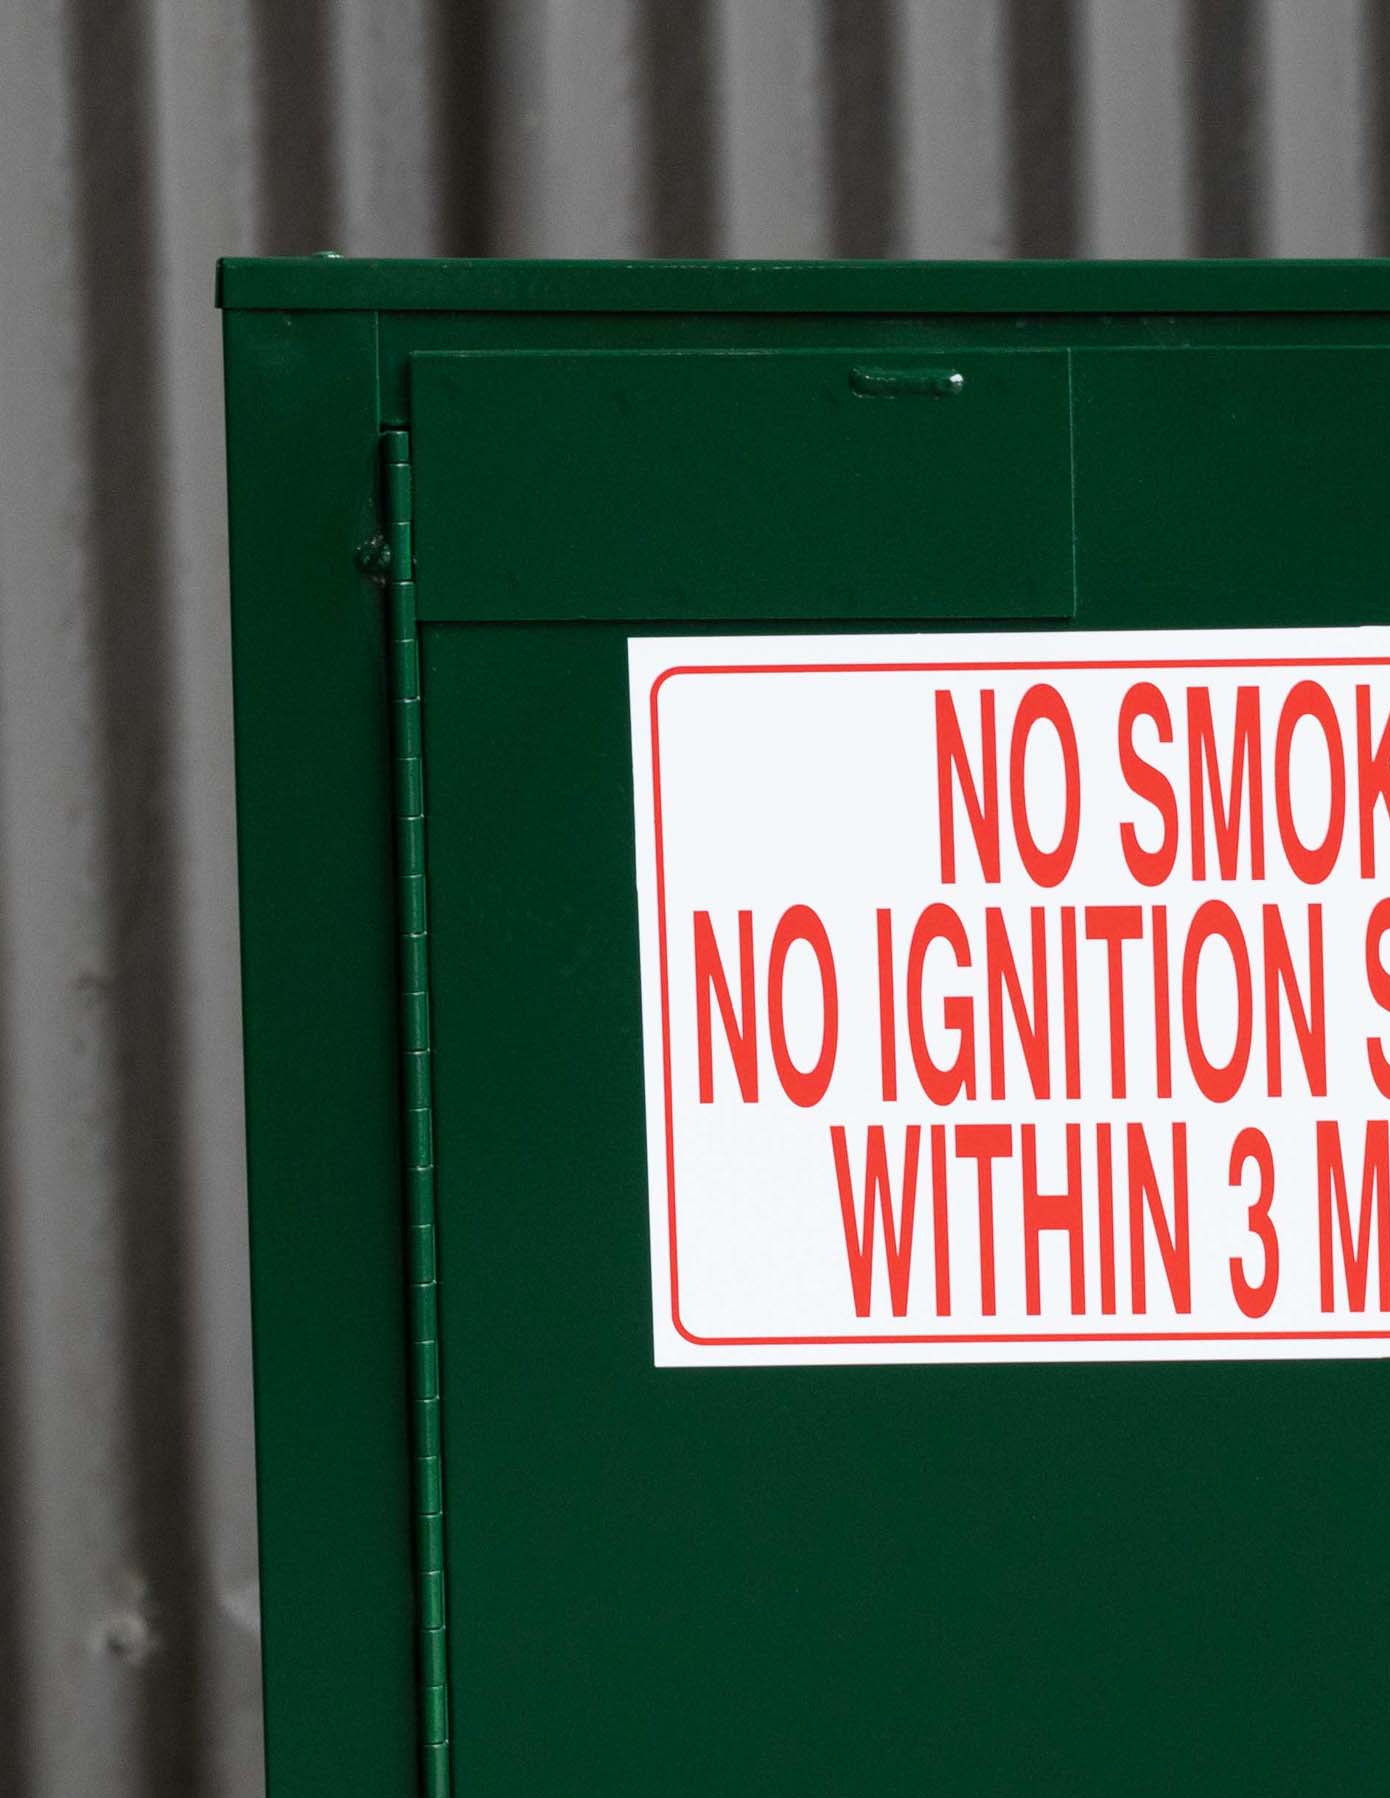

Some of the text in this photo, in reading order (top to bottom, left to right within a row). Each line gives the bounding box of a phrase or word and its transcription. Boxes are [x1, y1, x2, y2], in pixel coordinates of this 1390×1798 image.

[935, 683, 1080, 888] NO
[693, 904, 838, 1108] NO
[876, 899, 1327, 1106] IGNITION
[831, 1122, 1191, 1318] WITHIN
[1229, 1127, 1279, 1319] 3
